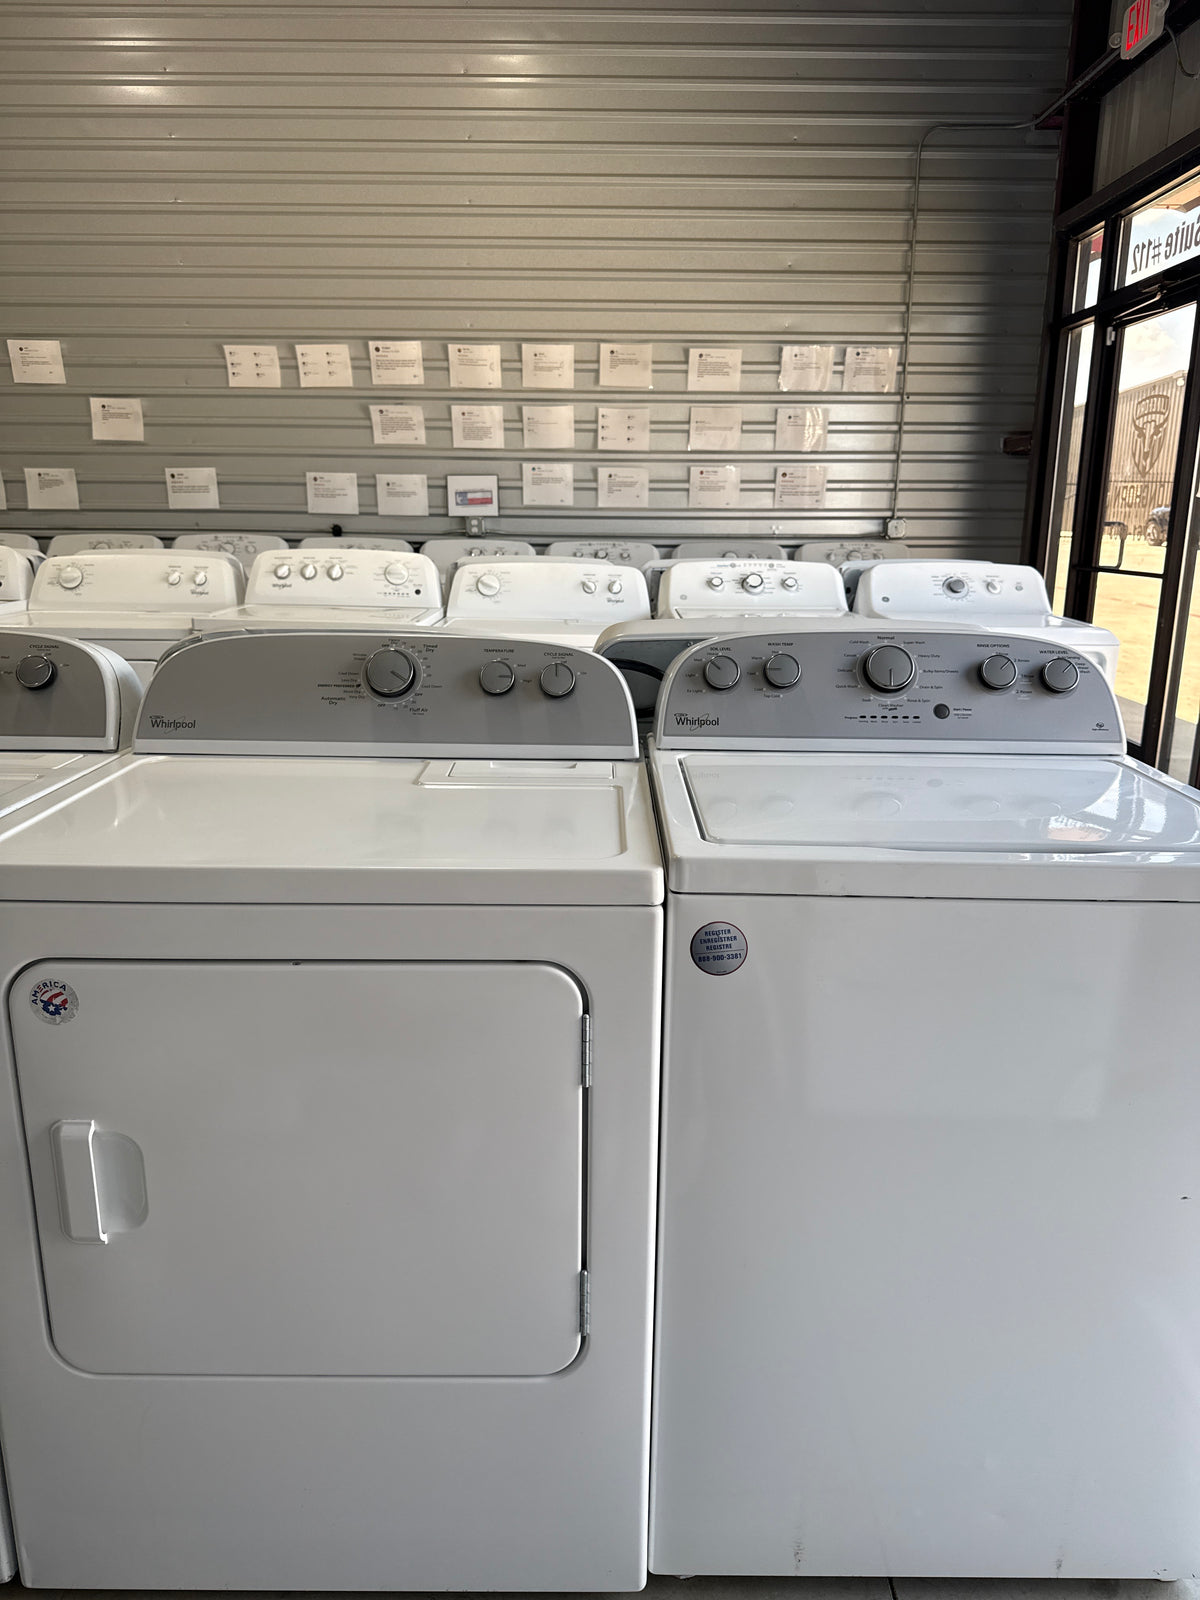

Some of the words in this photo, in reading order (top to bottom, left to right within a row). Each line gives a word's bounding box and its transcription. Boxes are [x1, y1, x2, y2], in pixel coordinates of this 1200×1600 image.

[150, 719, 196, 731] Whirlpool
[675, 716, 720, 728] Whirlpool
[705, 929, 731, 937] REGISTER
[699, 935, 738, 945] ENREGISTRER
[31, 980, 67, 1006] AMERICA
